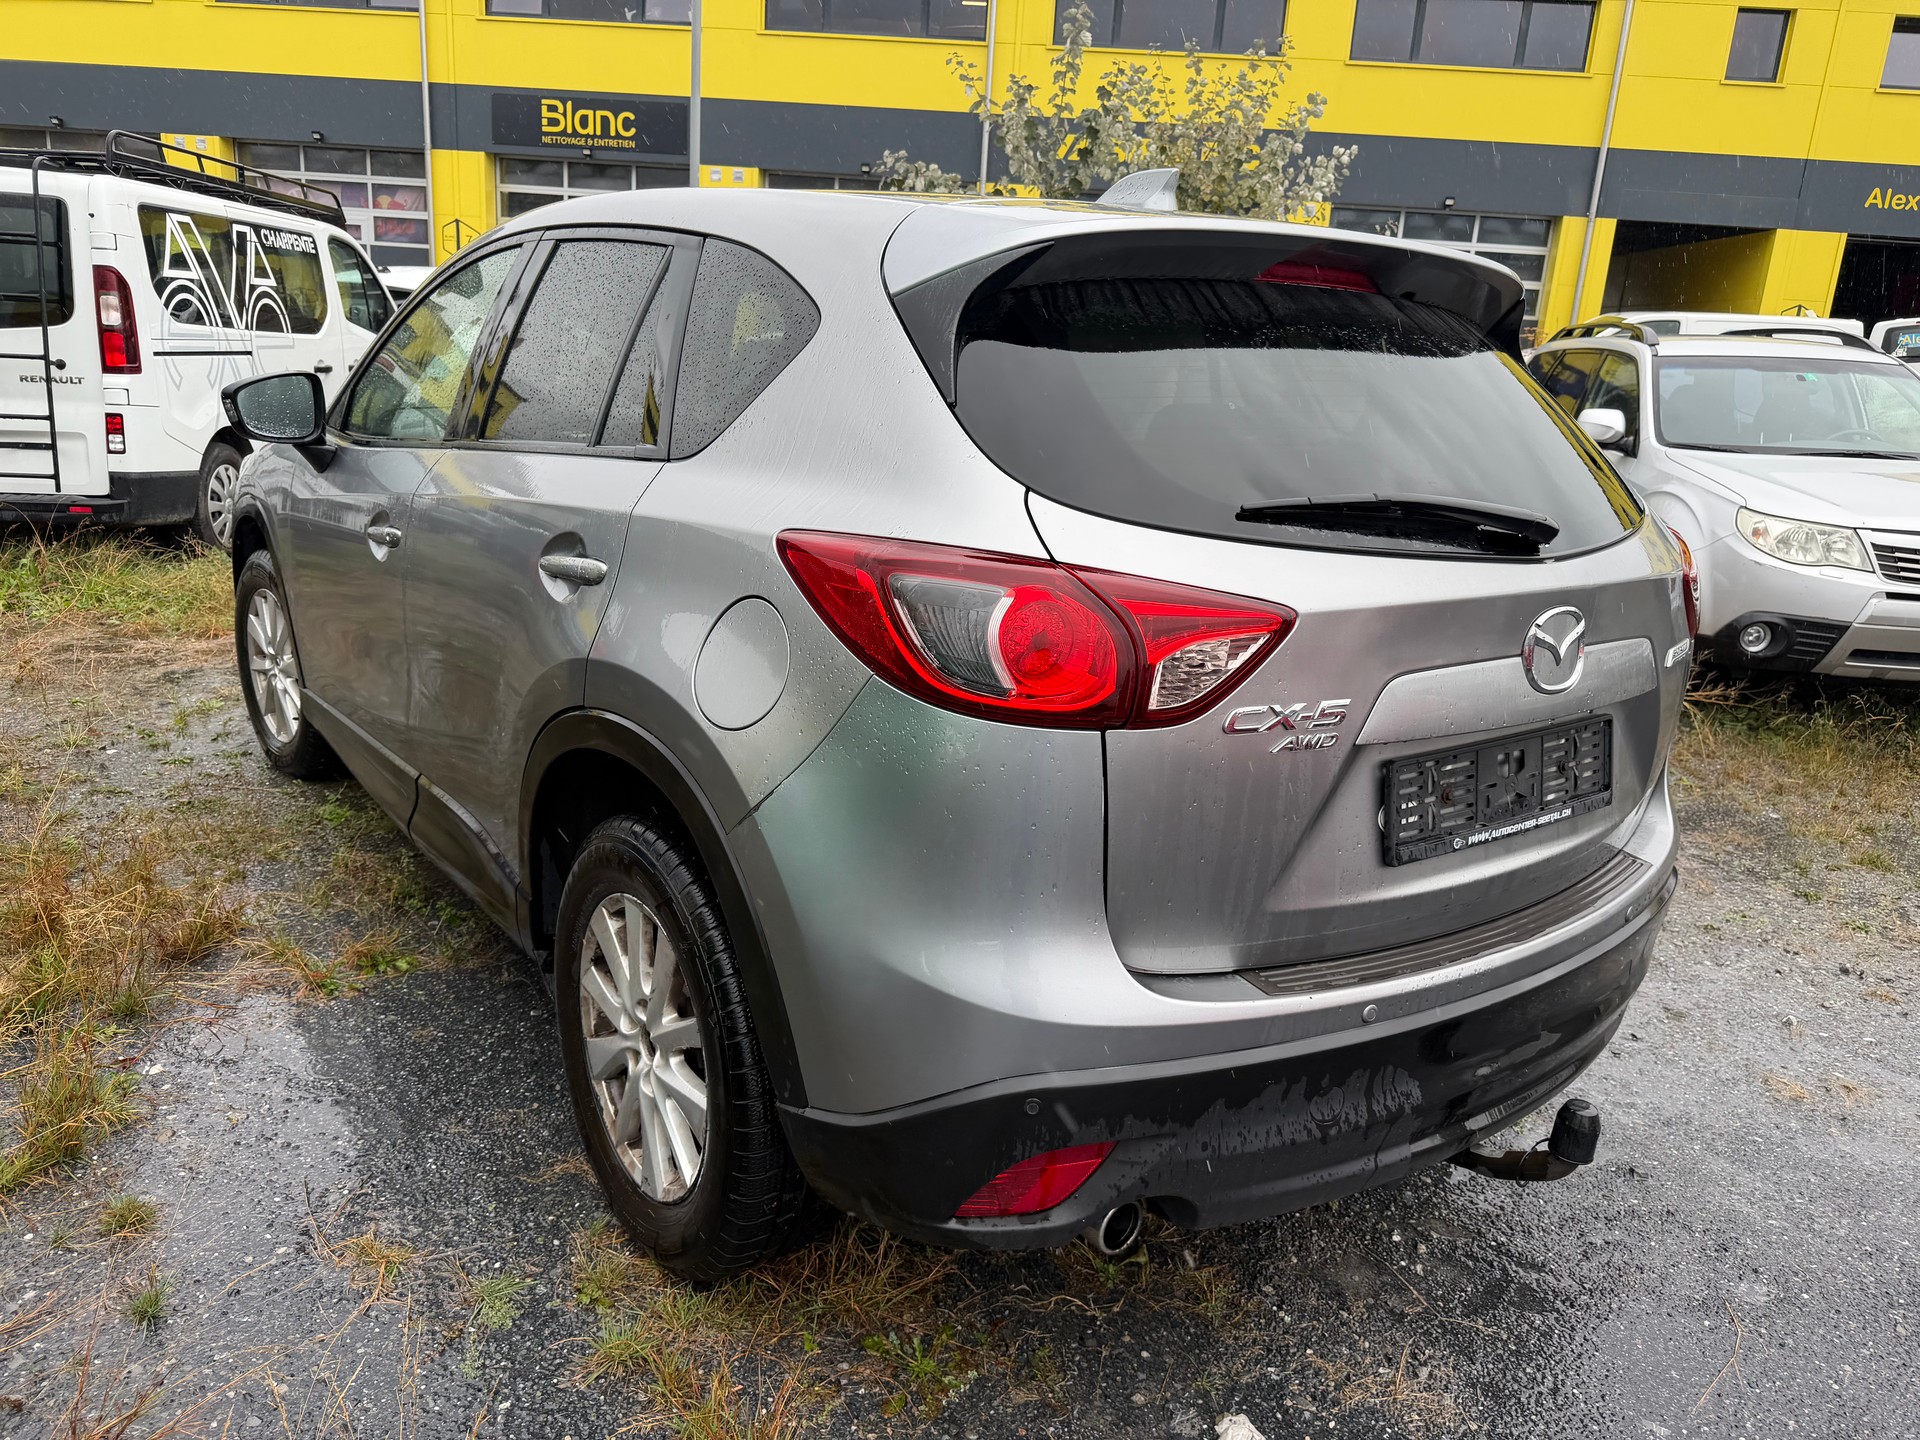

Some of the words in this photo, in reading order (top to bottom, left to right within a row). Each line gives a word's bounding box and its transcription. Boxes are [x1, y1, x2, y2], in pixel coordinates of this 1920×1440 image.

[541, 99, 636, 137] Blanc
[541, 135, 587, 146] NETTOYAGE
[587, 138, 593, 146] &
[594, 139, 636, 149] ENTRETIEN
[1864, 187, 1920, 211] Alex
[260, 228, 317, 254] CHARPENTE
[1222, 698, 1351, 735] CX-5
[1268, 732, 1339, 753] AWD
